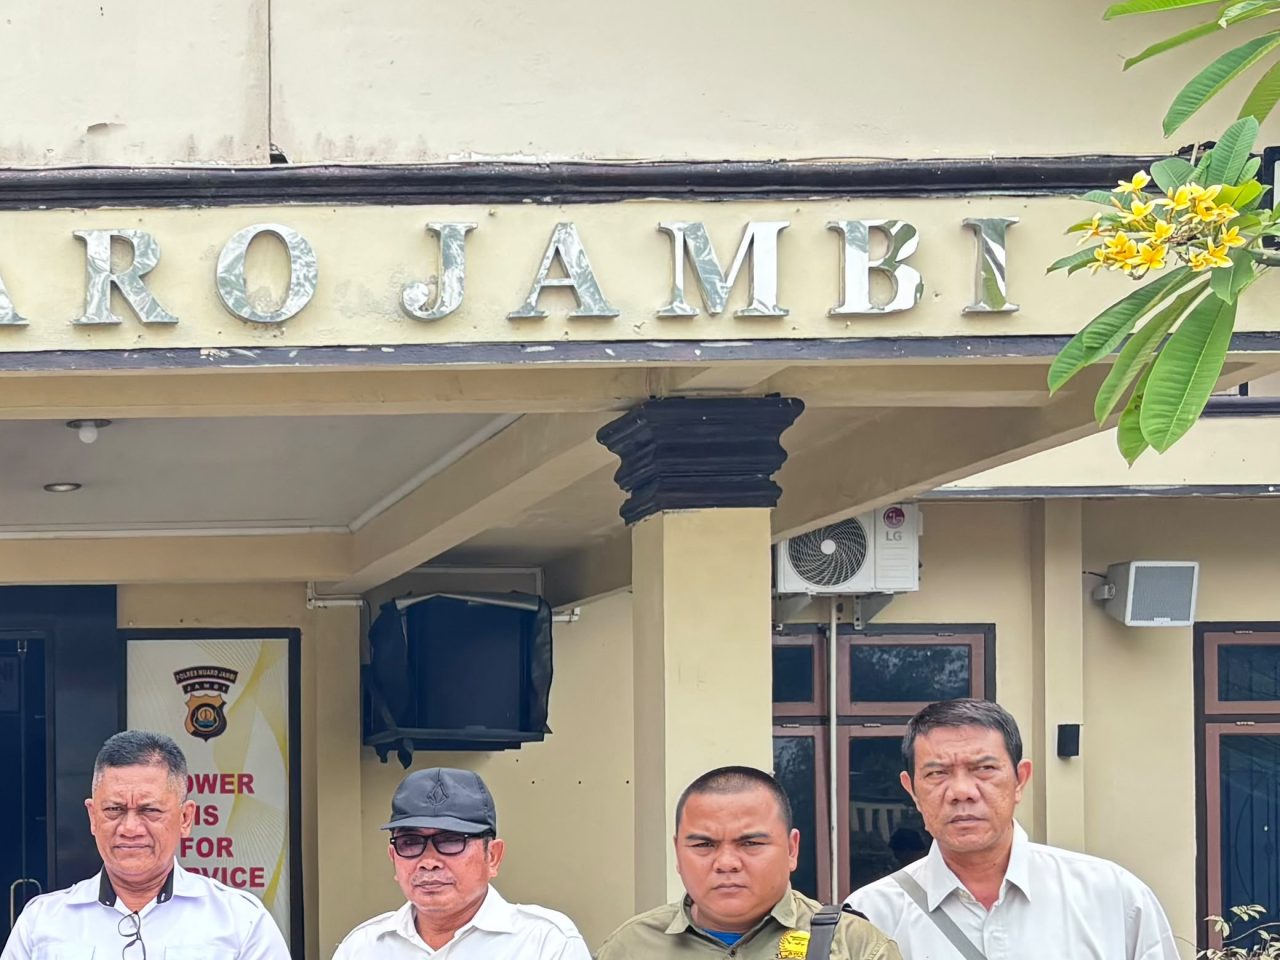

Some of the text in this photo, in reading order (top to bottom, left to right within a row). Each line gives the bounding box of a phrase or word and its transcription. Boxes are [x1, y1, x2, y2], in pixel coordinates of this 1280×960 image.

[399, 216, 1022, 322] JAMBI
[886, 531, 902, 541] LG
[187, 773, 255, 795] WER
[194, 805, 219, 826] IS
[180, 837, 234, 858] FOR
[184, 866, 265, 889] VICE
